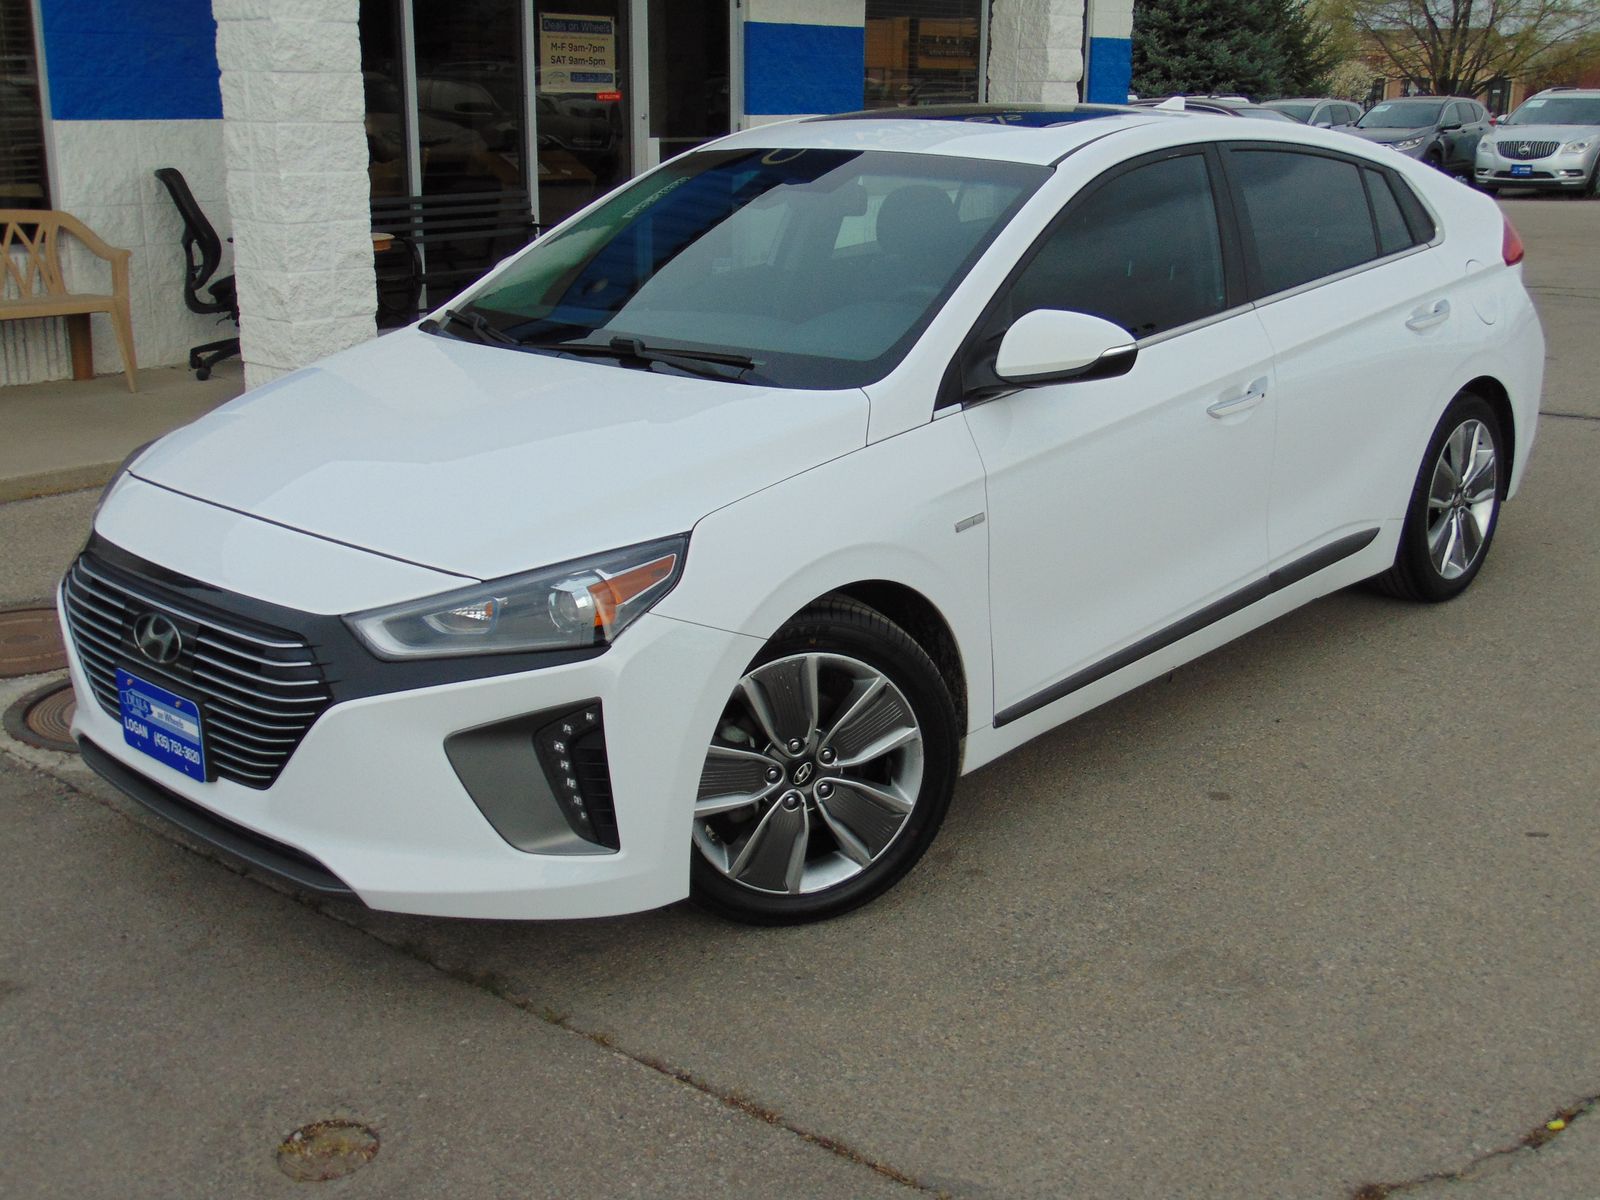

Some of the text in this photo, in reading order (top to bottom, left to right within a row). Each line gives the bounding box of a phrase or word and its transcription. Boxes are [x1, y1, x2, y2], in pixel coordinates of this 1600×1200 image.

[544, 20, 610, 32] Deals on Wheels
[551, 43, 605, 53] M-F 9am-7pm
[551, 56, 605, 66] SAT 9am-5pm
[125, 717, 200, 765] LOGAN (435) 752-3620
